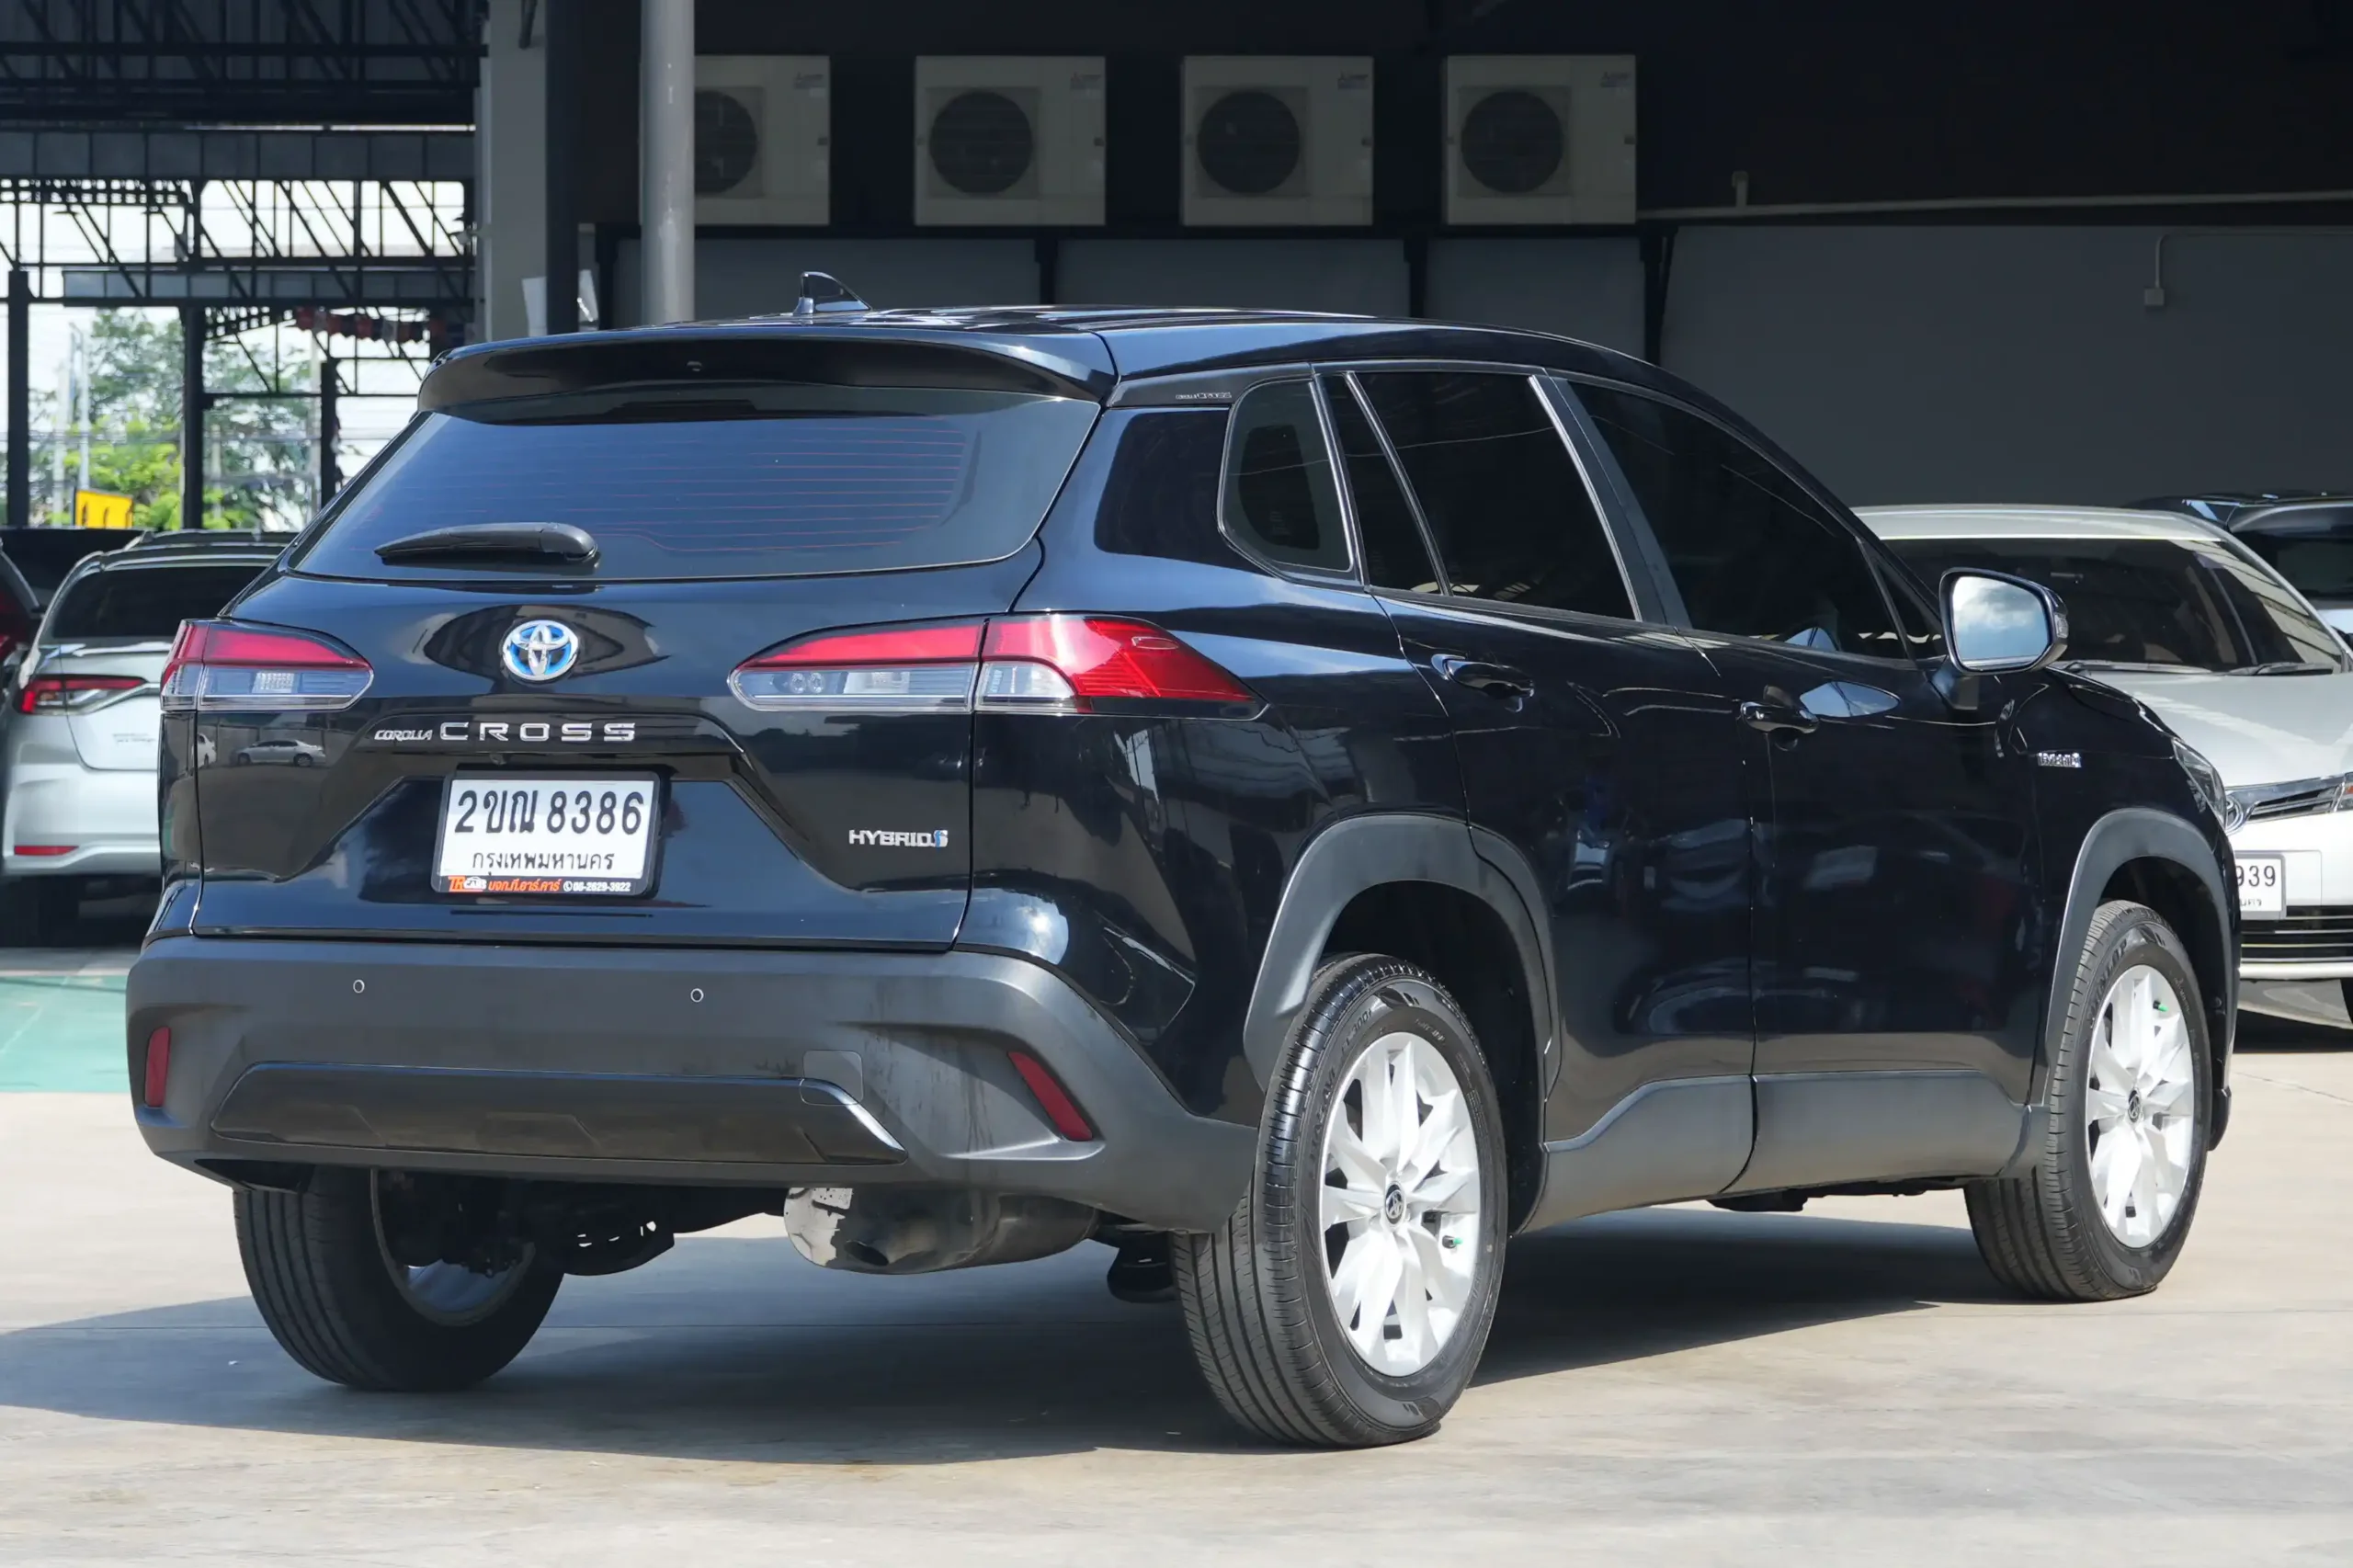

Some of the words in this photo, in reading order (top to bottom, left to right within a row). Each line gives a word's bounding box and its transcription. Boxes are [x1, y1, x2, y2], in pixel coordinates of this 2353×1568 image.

[374, 729, 433, 742] COROLLA
[439, 722, 636, 742] CROSS
[454, 790, 539, 834] 2ขณ
[547, 790, 644, 835] 8386
[848, 829, 932, 847] HYBRID
[472, 852, 615, 876] กรุงเทพมหานคร
